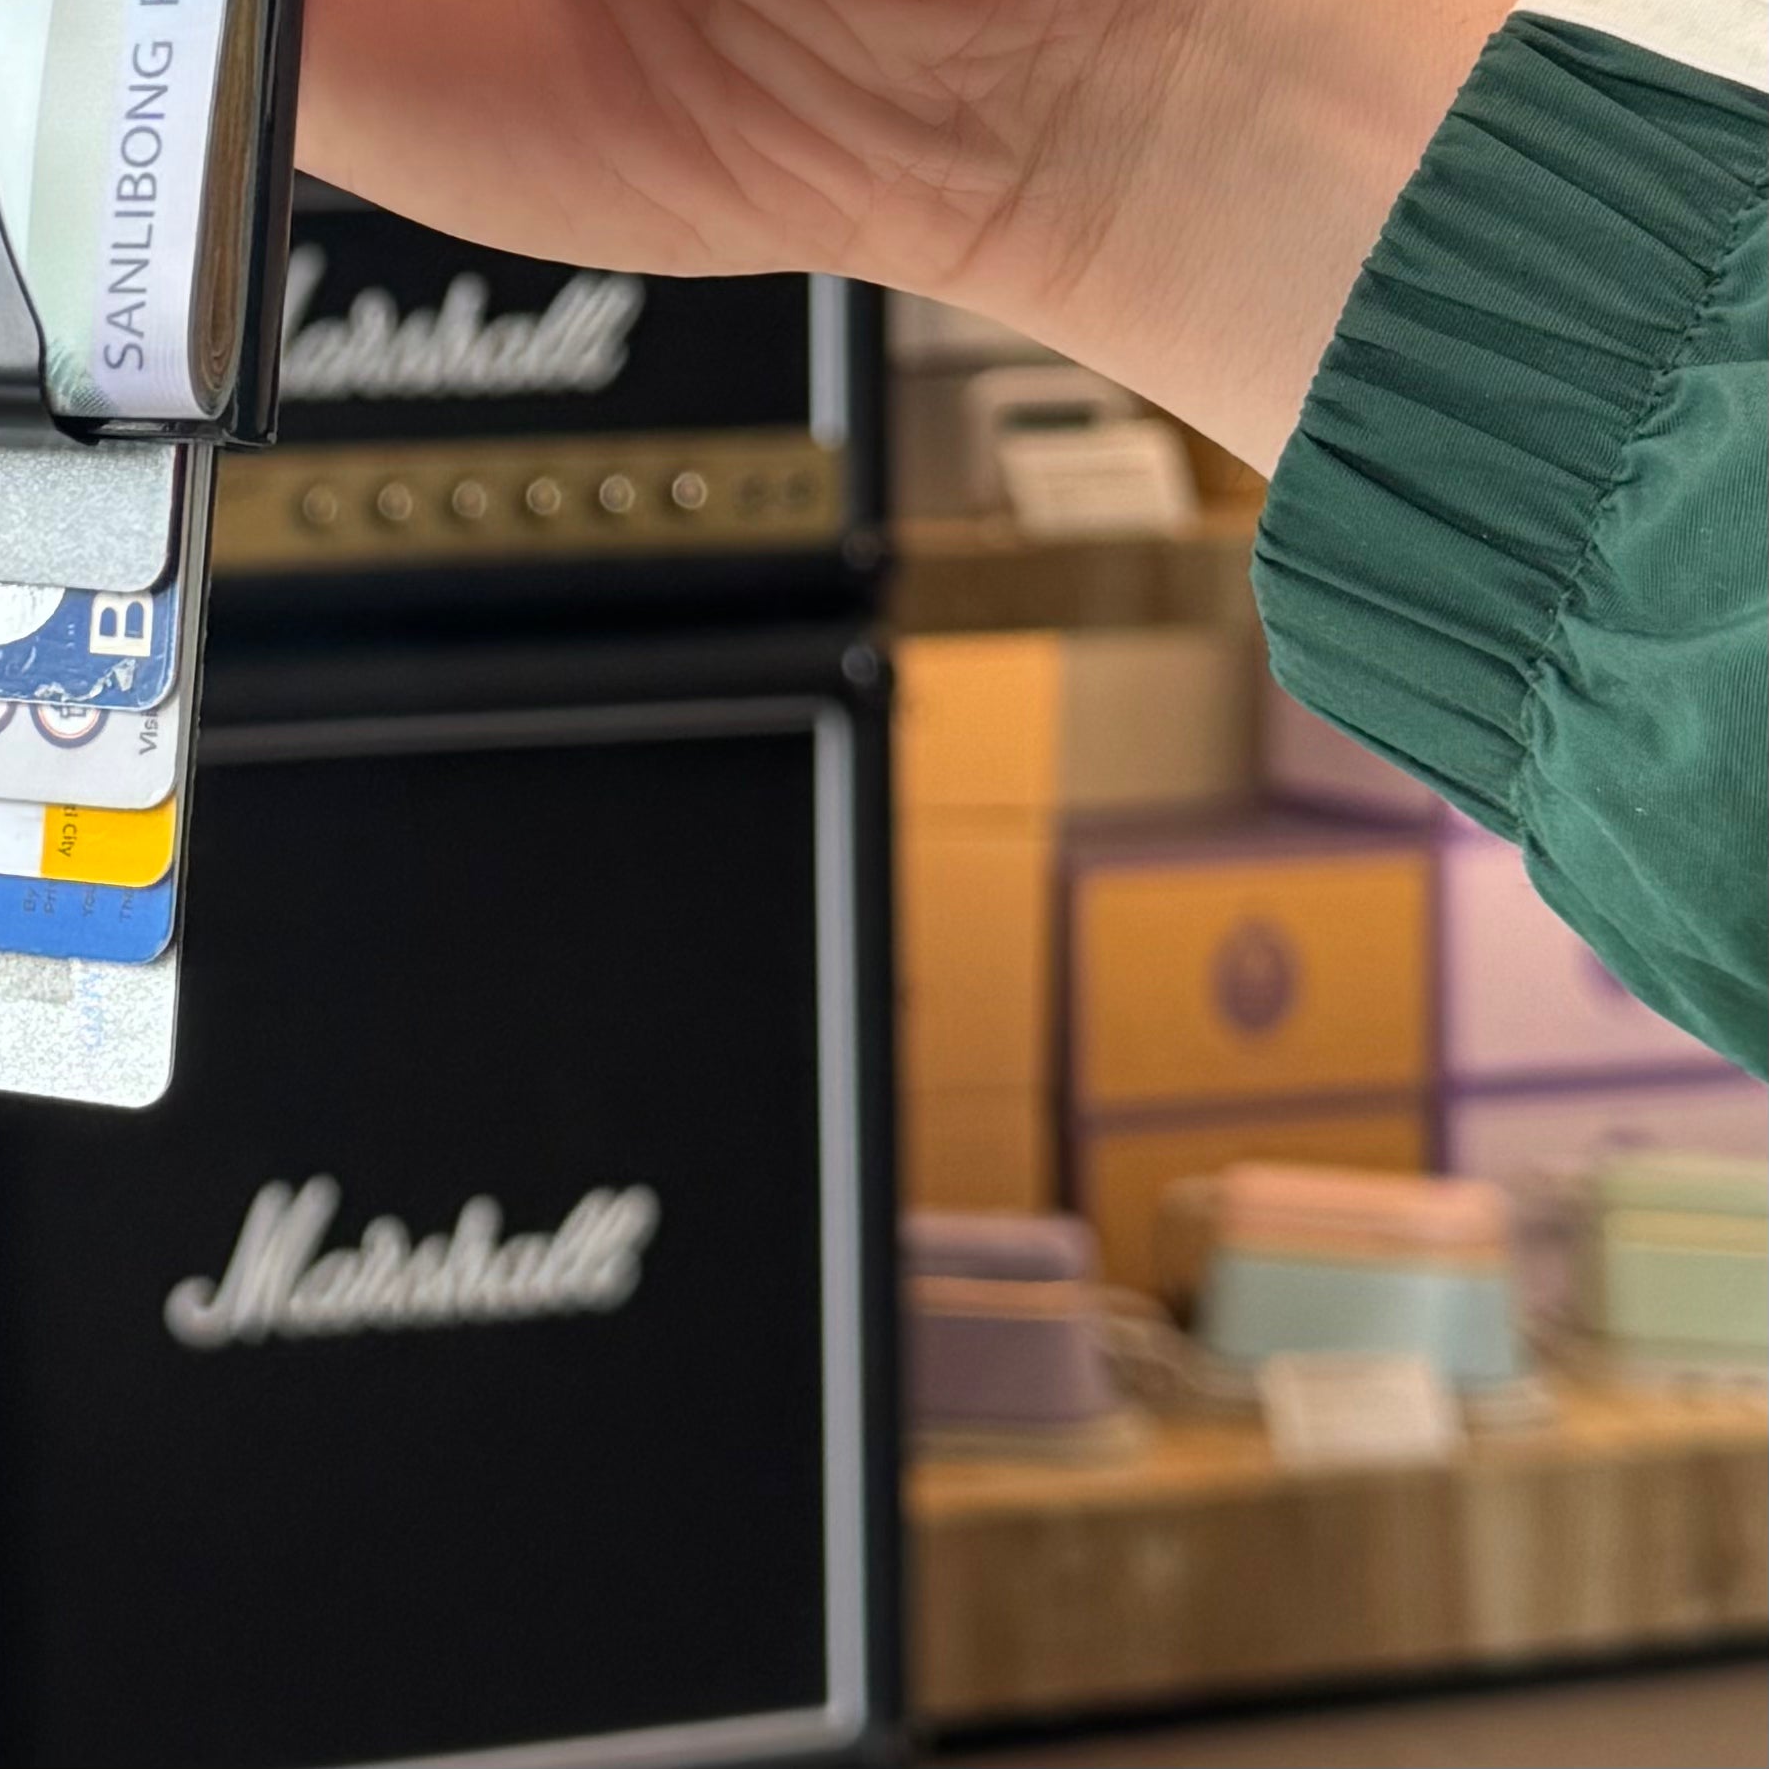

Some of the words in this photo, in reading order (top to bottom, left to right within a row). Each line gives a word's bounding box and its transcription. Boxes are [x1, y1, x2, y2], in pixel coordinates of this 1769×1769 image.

[102, 41, 174, 371] SANLIBONG
[280, 242, 645, 402] arshall
[90, 591, 153, 657] B
[56, 823, 78, 858] City
[164, 1173, 661, 1349] Marshall
